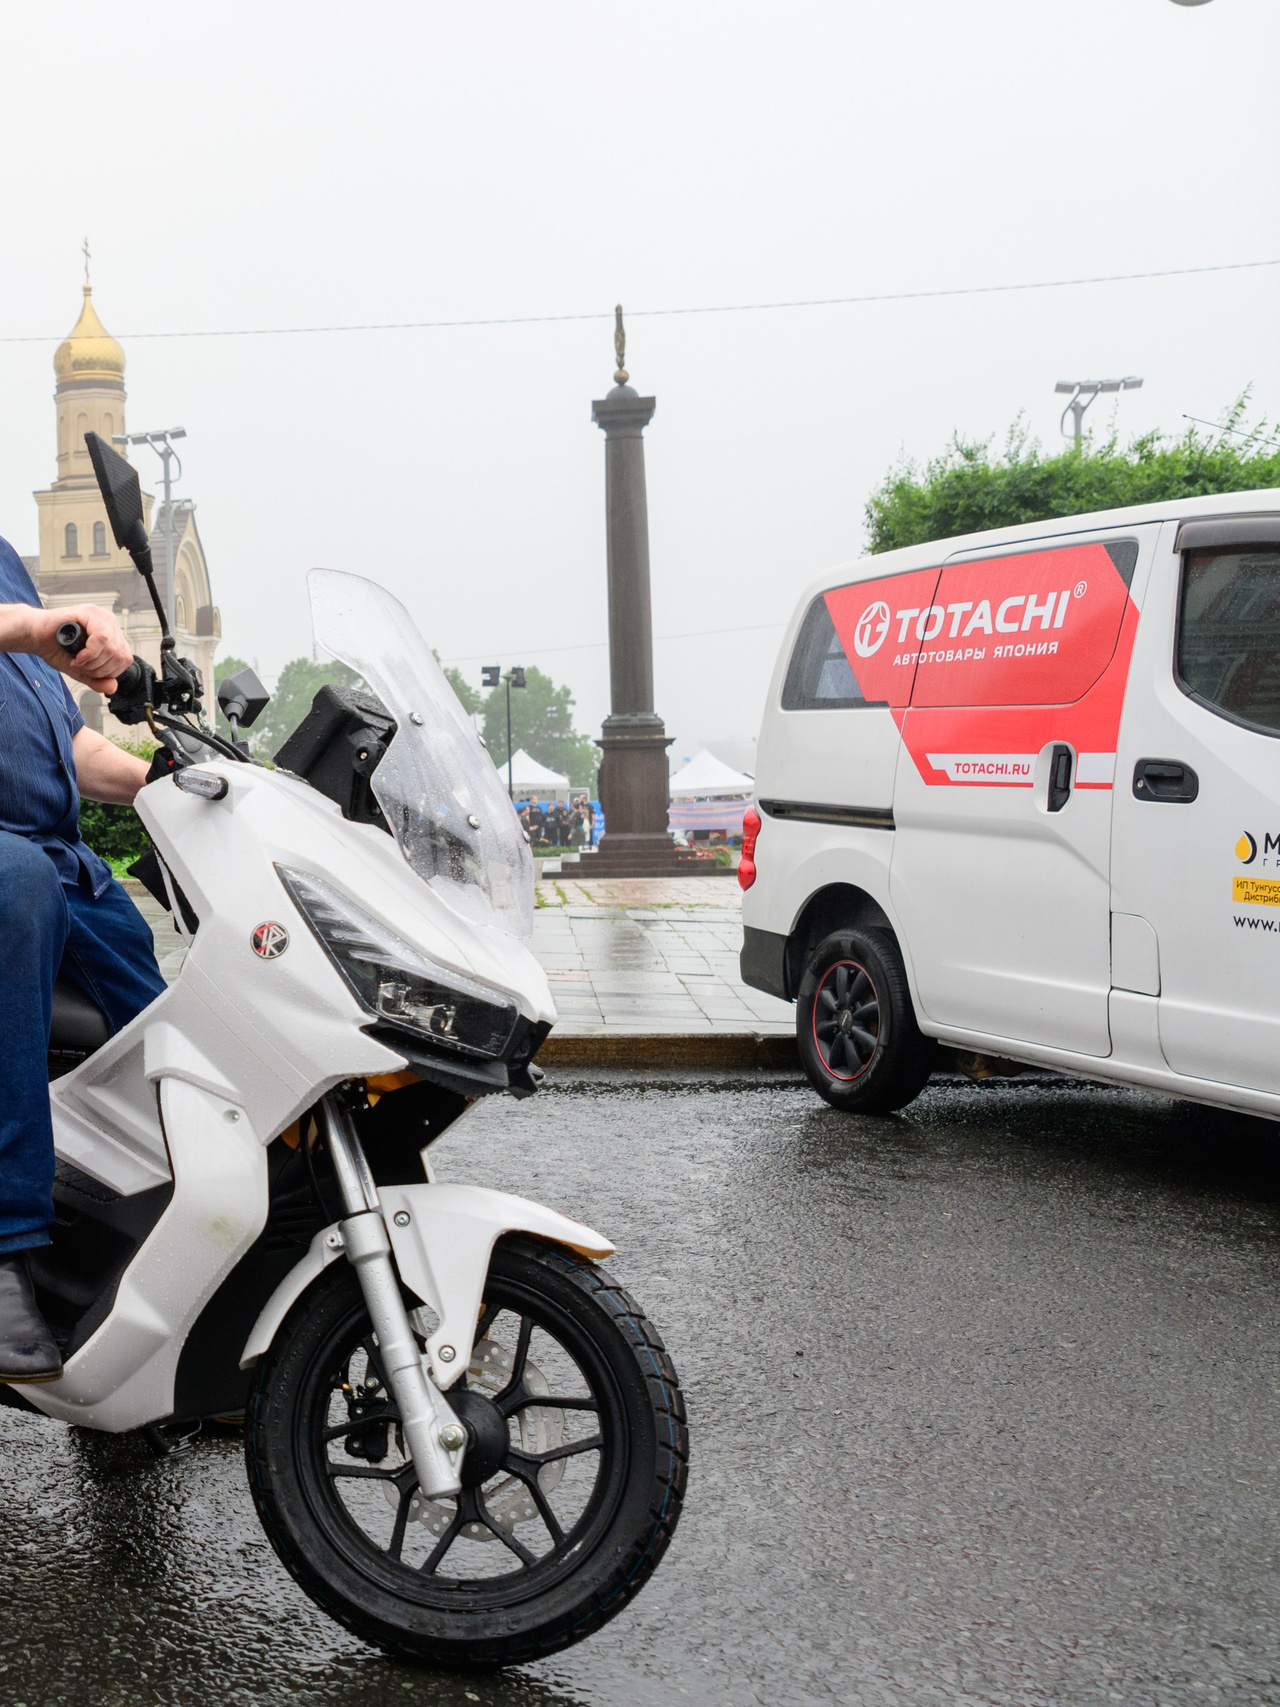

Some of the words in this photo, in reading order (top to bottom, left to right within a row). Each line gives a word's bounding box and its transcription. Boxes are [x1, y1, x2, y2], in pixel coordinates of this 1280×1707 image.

[895, 590, 1071, 644] TOTACHI
[893, 648, 986, 667] АВТОТОВАРЫ
[993, 642, 1059, 659] ЯПОНИЯ
[955, 763, 1030, 775] TOTACHI.RU
[1236, 880, 1249, 889] ИП
[1243, 891, 1280, 904] Дистриб
[1233, 916, 1280, 933] www.
